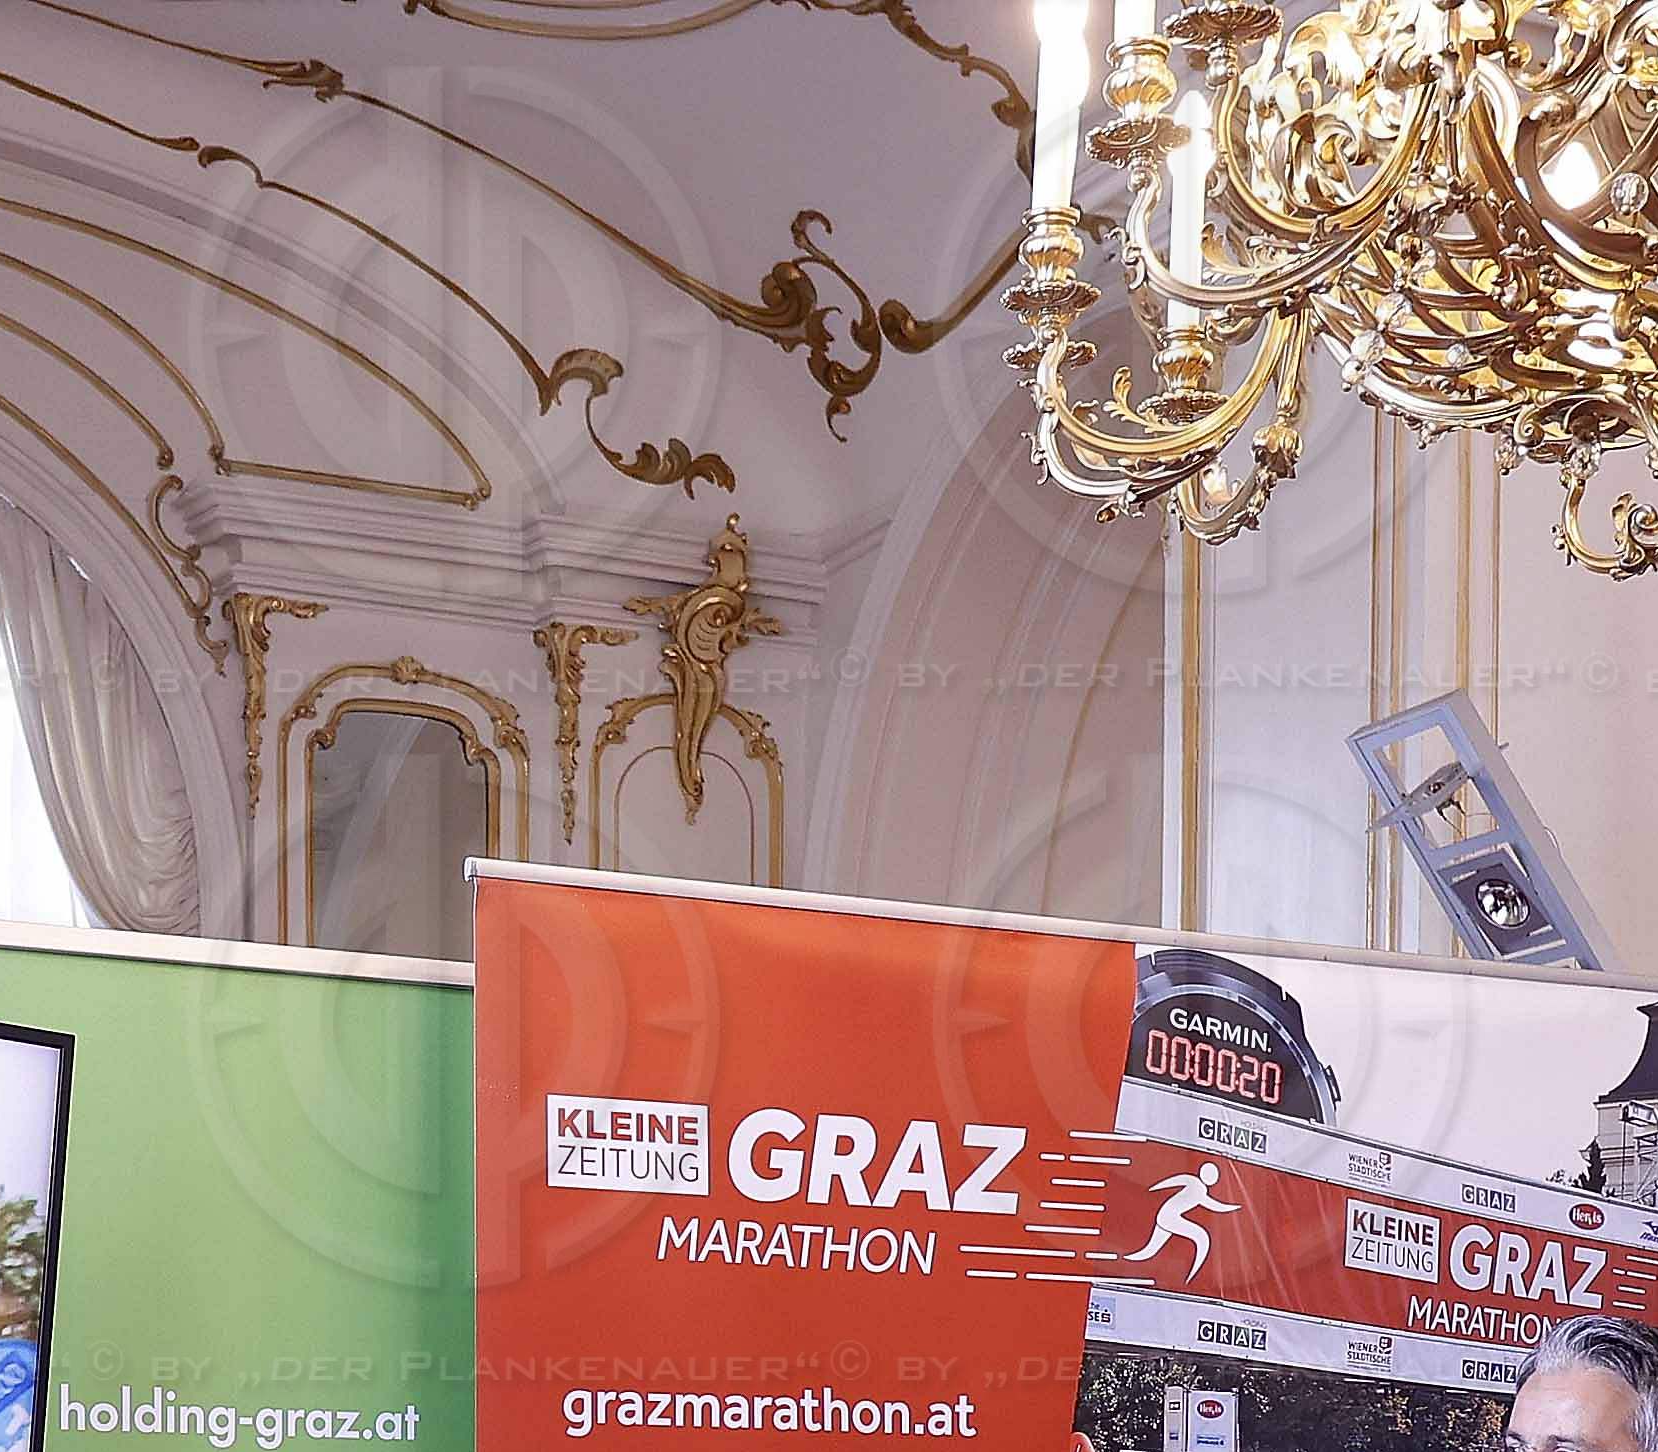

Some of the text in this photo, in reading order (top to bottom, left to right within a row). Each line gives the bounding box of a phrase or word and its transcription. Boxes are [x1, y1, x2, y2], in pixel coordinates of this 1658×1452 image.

[1145, 1029, 1282, 1104] 00:00:20
[557, 1107, 699, 1147] KLEINE
[1199, 1117, 1267, 1153] GRAZ
[557, 1144, 699, 1183] ZEITUNG
[727, 1107, 1028, 1215] GRAZ
[1347, 1150, 1379, 1169] WIENER
[1461, 1184, 1516, 1213] GRAZ
[656, 1216, 937, 1275] MARATHON
[1352, 1208, 1435, 1248] KLEINE
[1351, 1235, 1435, 1275] ZEITUNG
[1449, 1223, 1609, 1310] GRAZ
[1198, 1320, 1268, 1351] GRAZ
[1347, 1340, 1379, 1355] WIENER
[1461, 1358, 1517, 1384] GRAZ
[59, 1383, 420, 1450] holding-graz.at
[561, 1387, 978, 1438] grazmarathon.at
